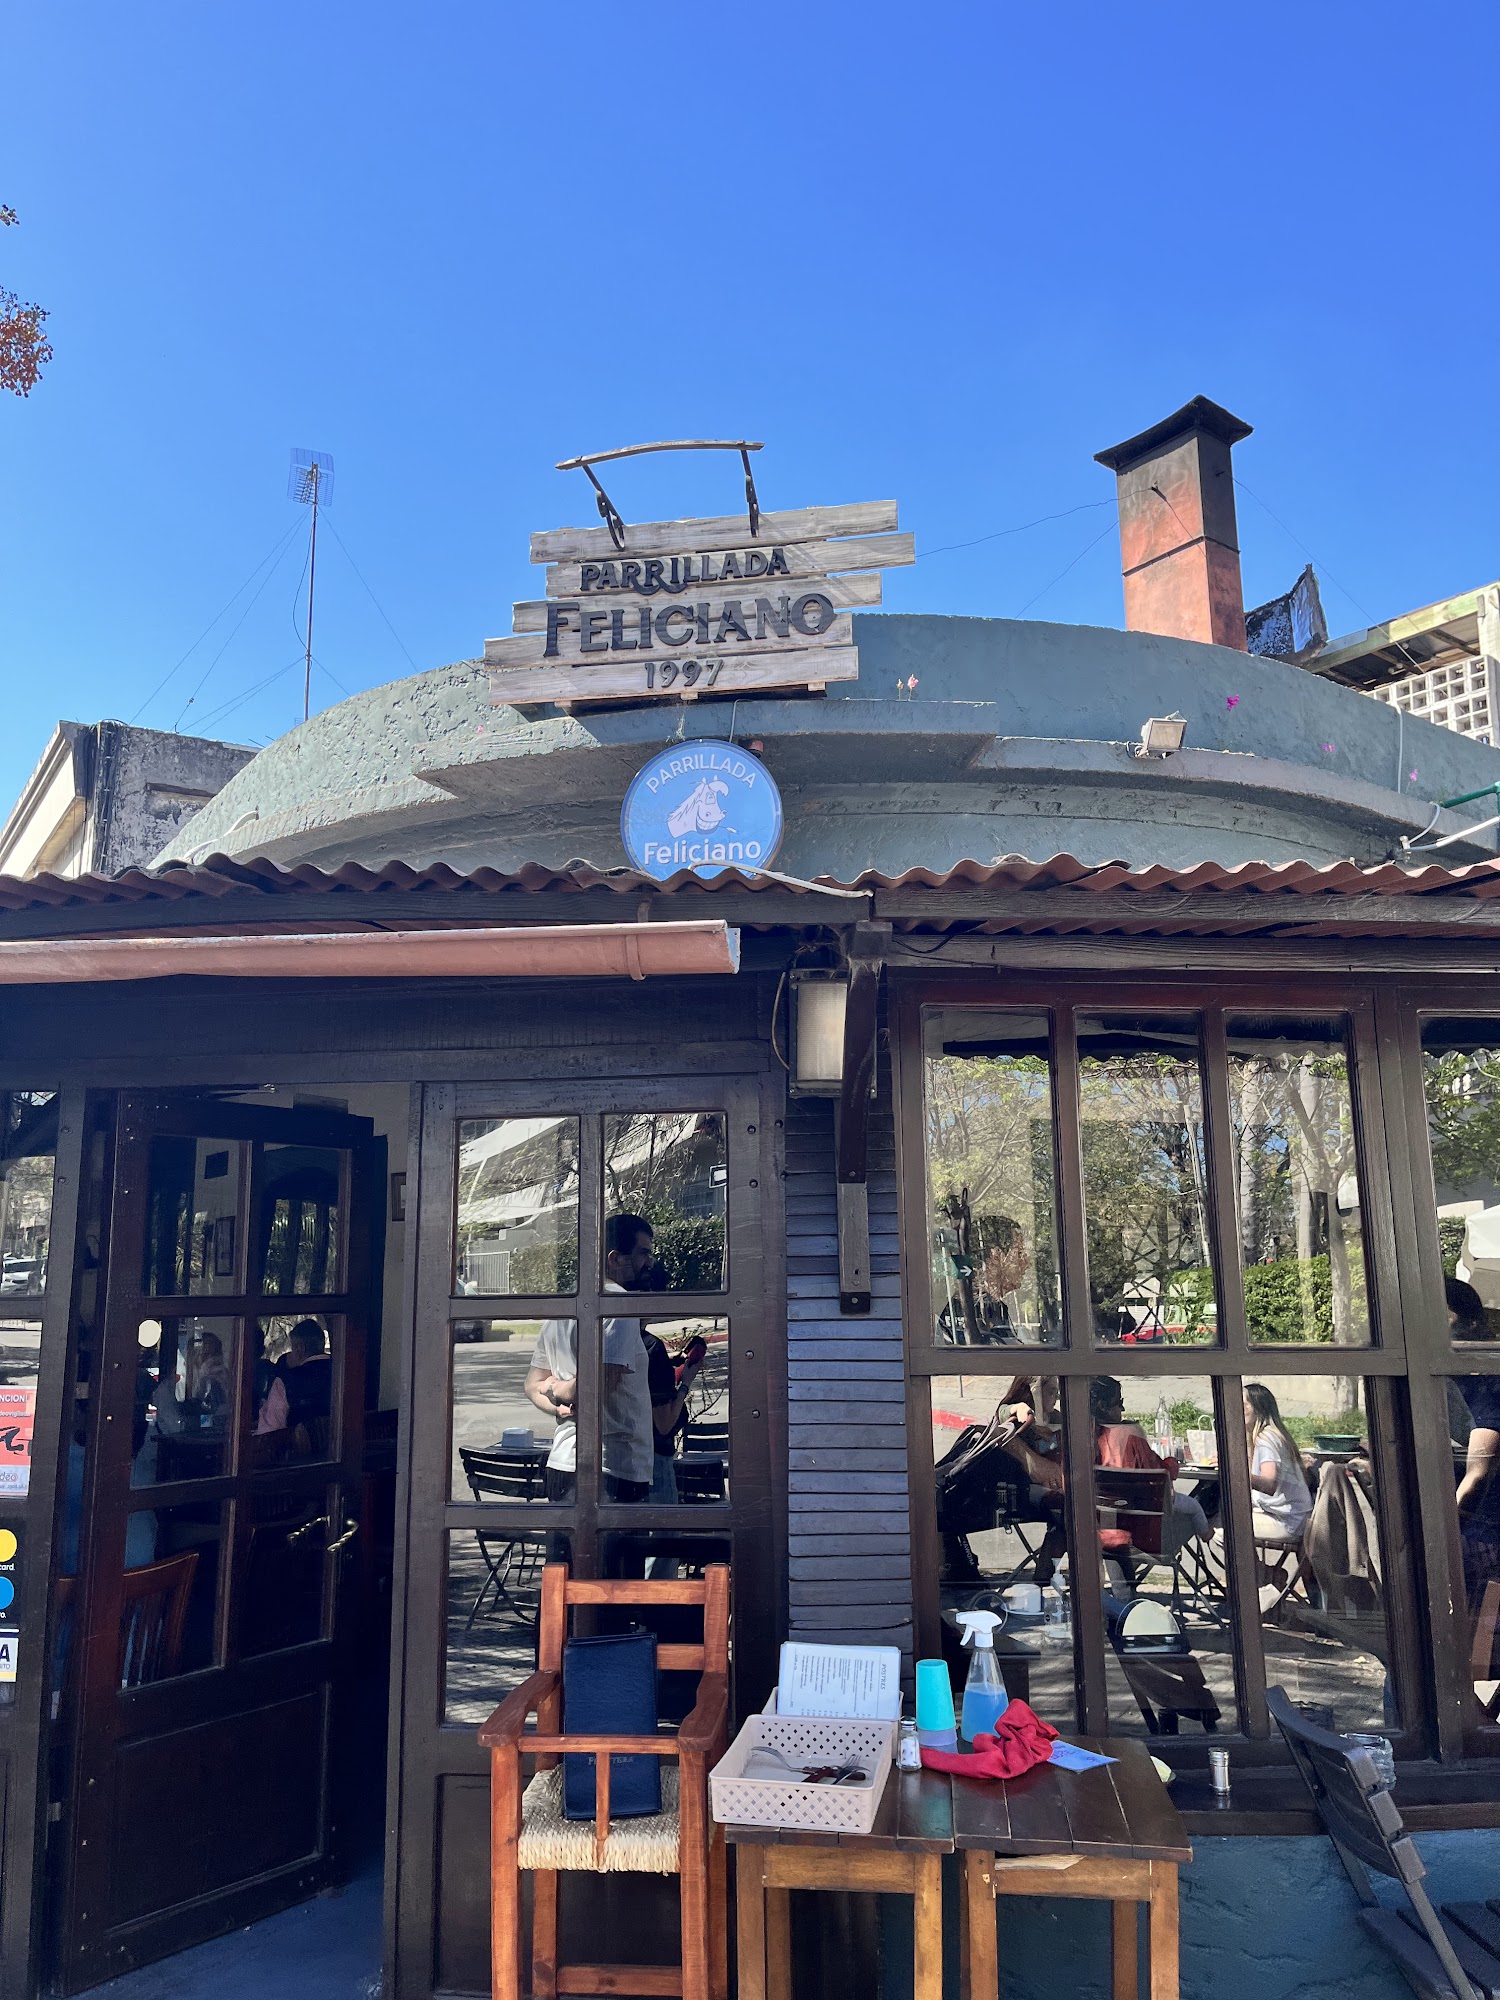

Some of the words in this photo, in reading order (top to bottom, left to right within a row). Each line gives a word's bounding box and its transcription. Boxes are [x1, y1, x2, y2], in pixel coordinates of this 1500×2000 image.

[580, 548, 790, 595] PARRILLADA
[544, 593, 837, 657] FELICIANO
[645, 658, 724, 689] 1997
[646, 754, 756, 794] PARRILLADA
[644, 839, 761, 865] Feliciano
